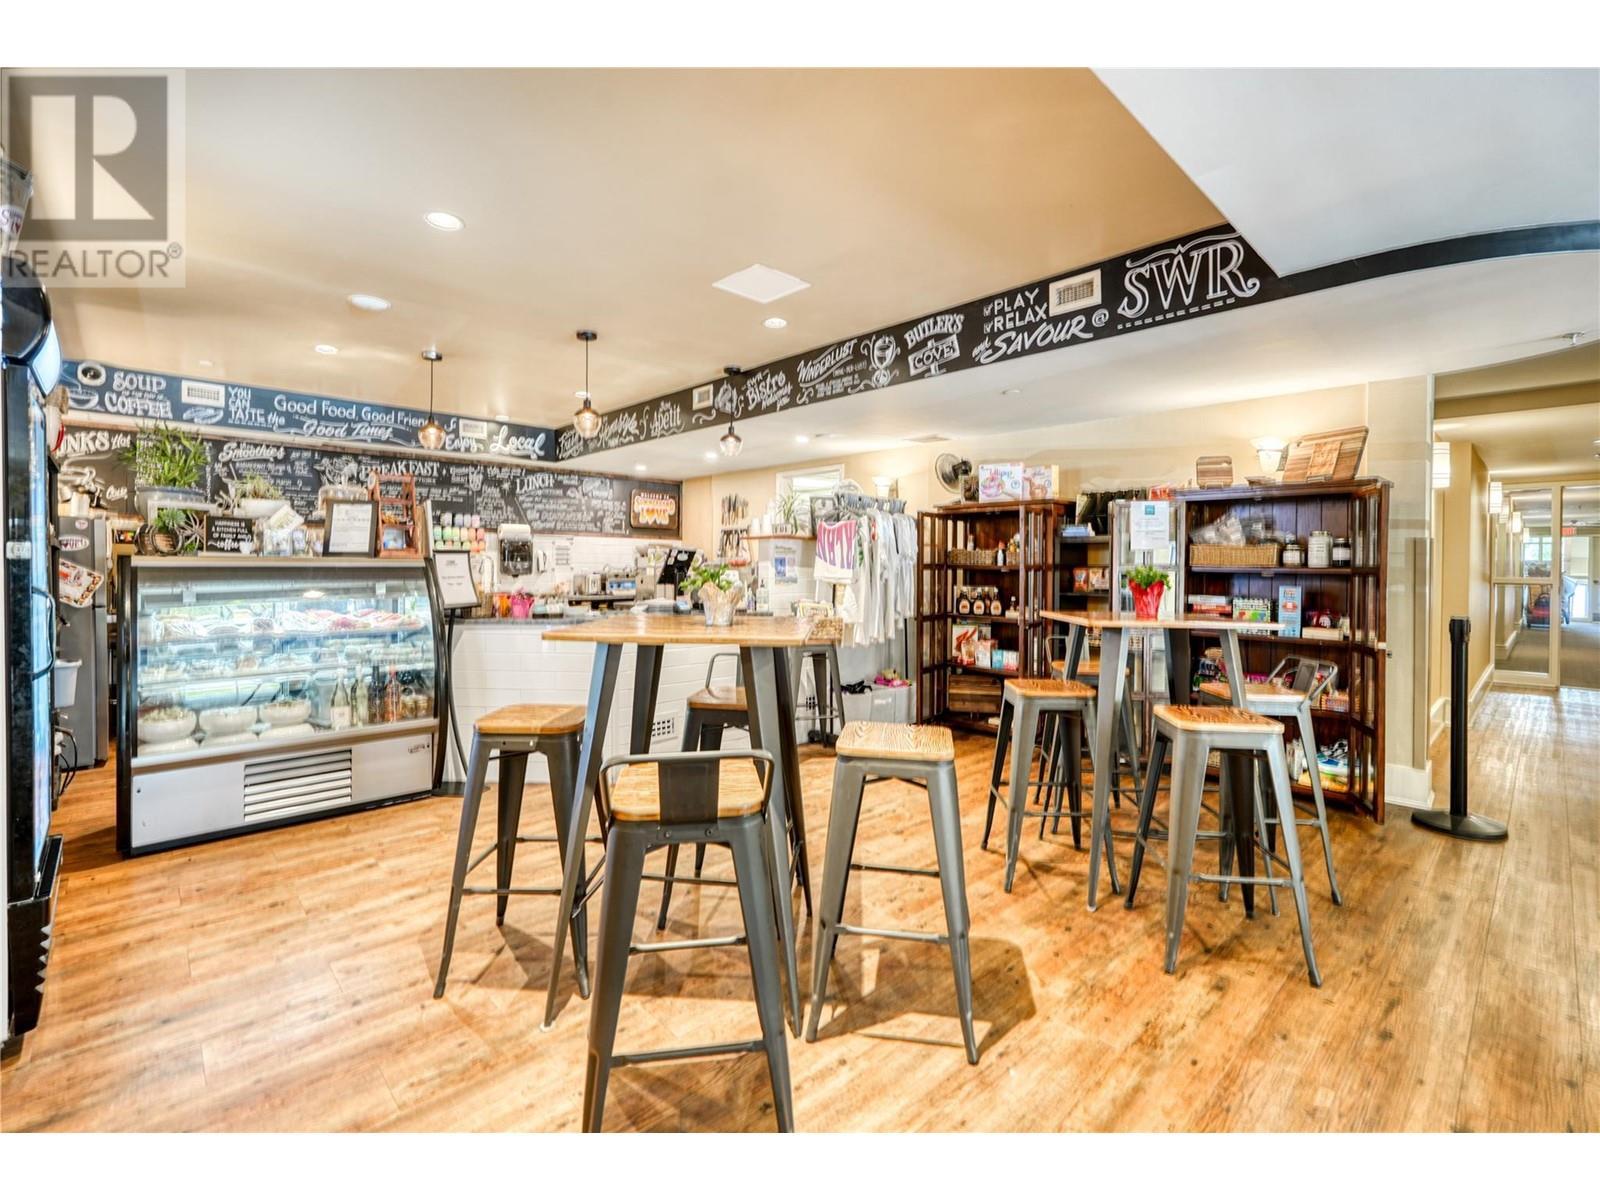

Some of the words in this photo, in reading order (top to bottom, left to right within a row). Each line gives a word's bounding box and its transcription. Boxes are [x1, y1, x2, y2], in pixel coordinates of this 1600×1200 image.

[1117, 239, 1260, 319] SWR
[994, 288, 1039, 315] PLAY
[994, 302, 1047, 332] RELAX
[904, 313, 965, 350] BUTLER'S
[981, 314, 1093, 364] SAVOUR
[113, 371, 166, 394] SOUP
[228, 386, 251, 401] YOU
[104, 391, 174, 420] COFFEE
[228, 399, 250, 410] CAN
[230, 408, 265, 424] TASTE
[274, 394, 317, 415] Good
[362, 406, 394, 424] Good
[303, 419, 347, 437] Good
[489, 425, 547, 458] Local
[219, 441, 286, 463] Smoothies
[516, 472, 554, 495] LUNCH
